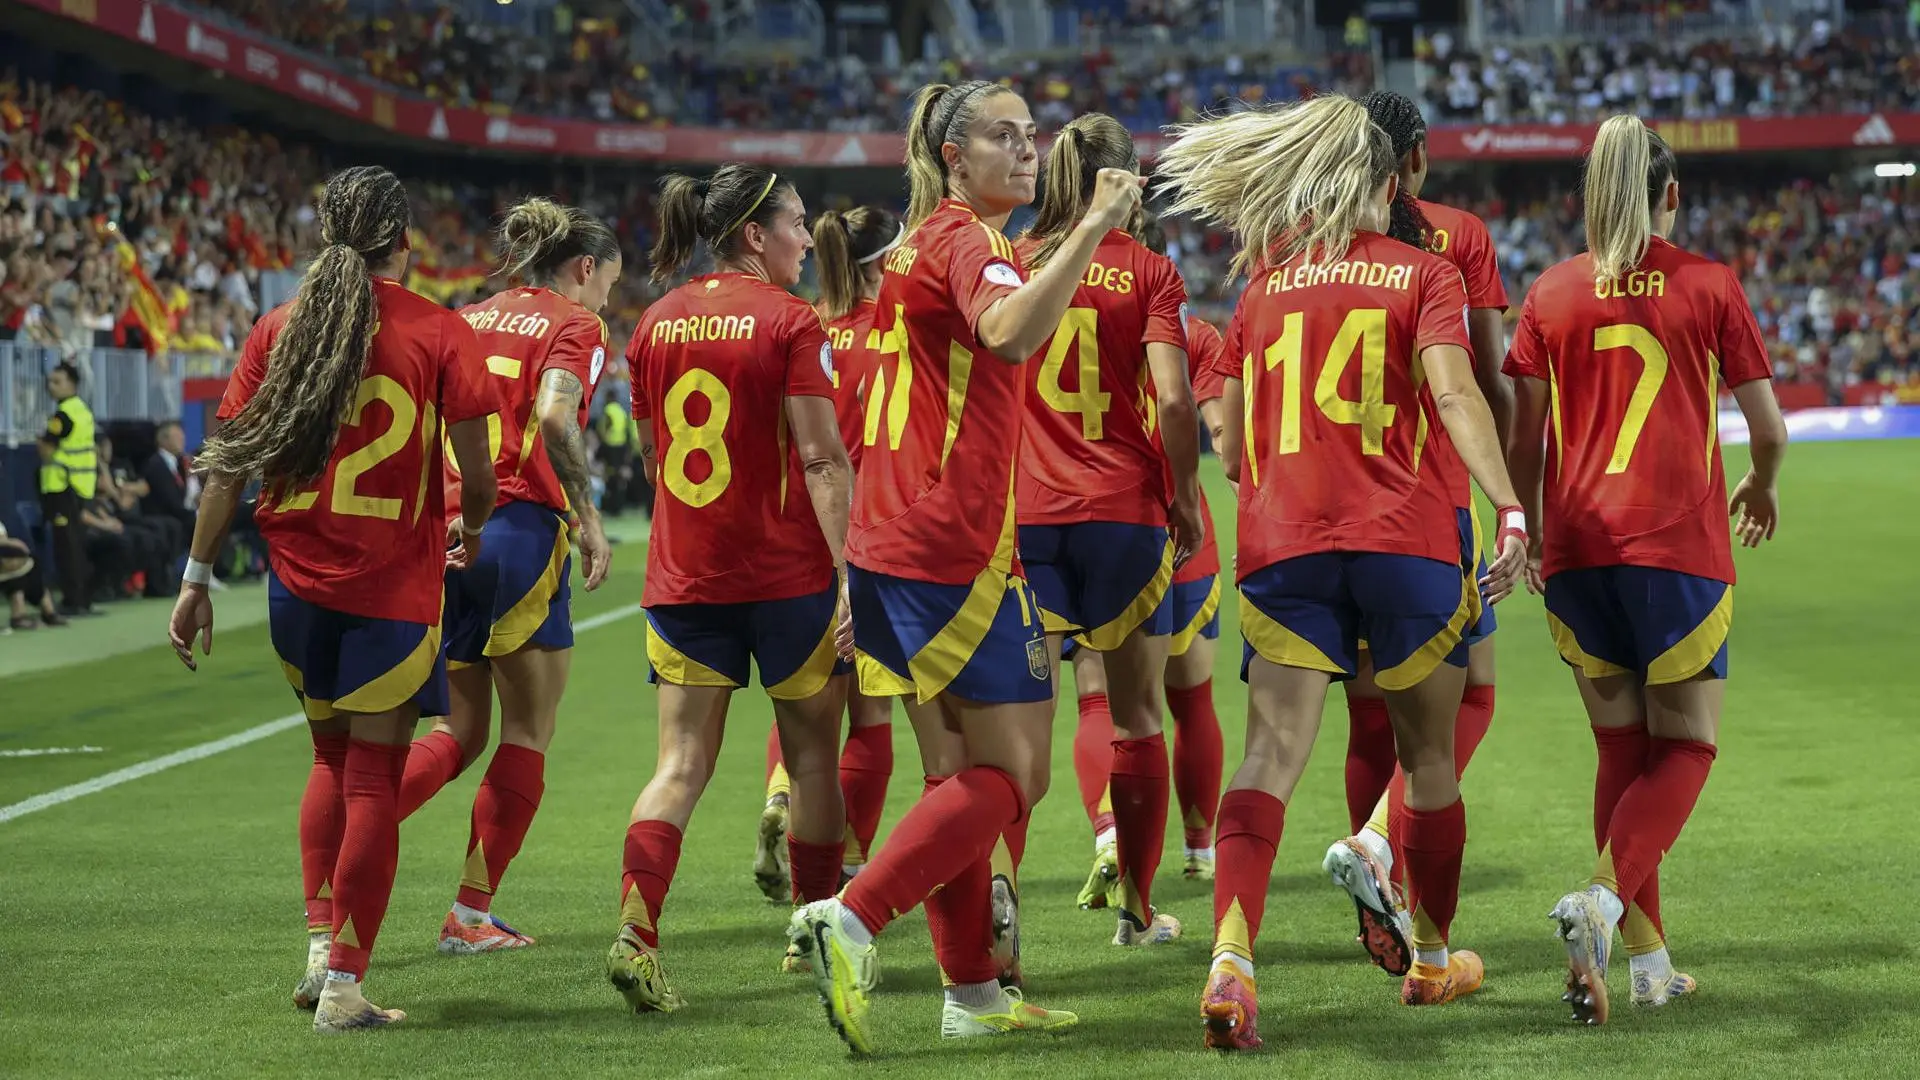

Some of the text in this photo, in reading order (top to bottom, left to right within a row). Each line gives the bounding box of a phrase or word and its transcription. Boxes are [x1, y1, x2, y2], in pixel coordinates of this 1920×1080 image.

[1266, 260, 1413, 296] ALEIXANDRI
[1595, 270, 1665, 299] OLGA
[496, 312, 550, 340] LEÓN
[652, 315, 755, 347] MARIONA
[1037, 308, 1111, 440] 4
[1265, 308, 1397, 457] 14
[1594, 324, 1668, 474] 7
[664, 368, 732, 508] 8
